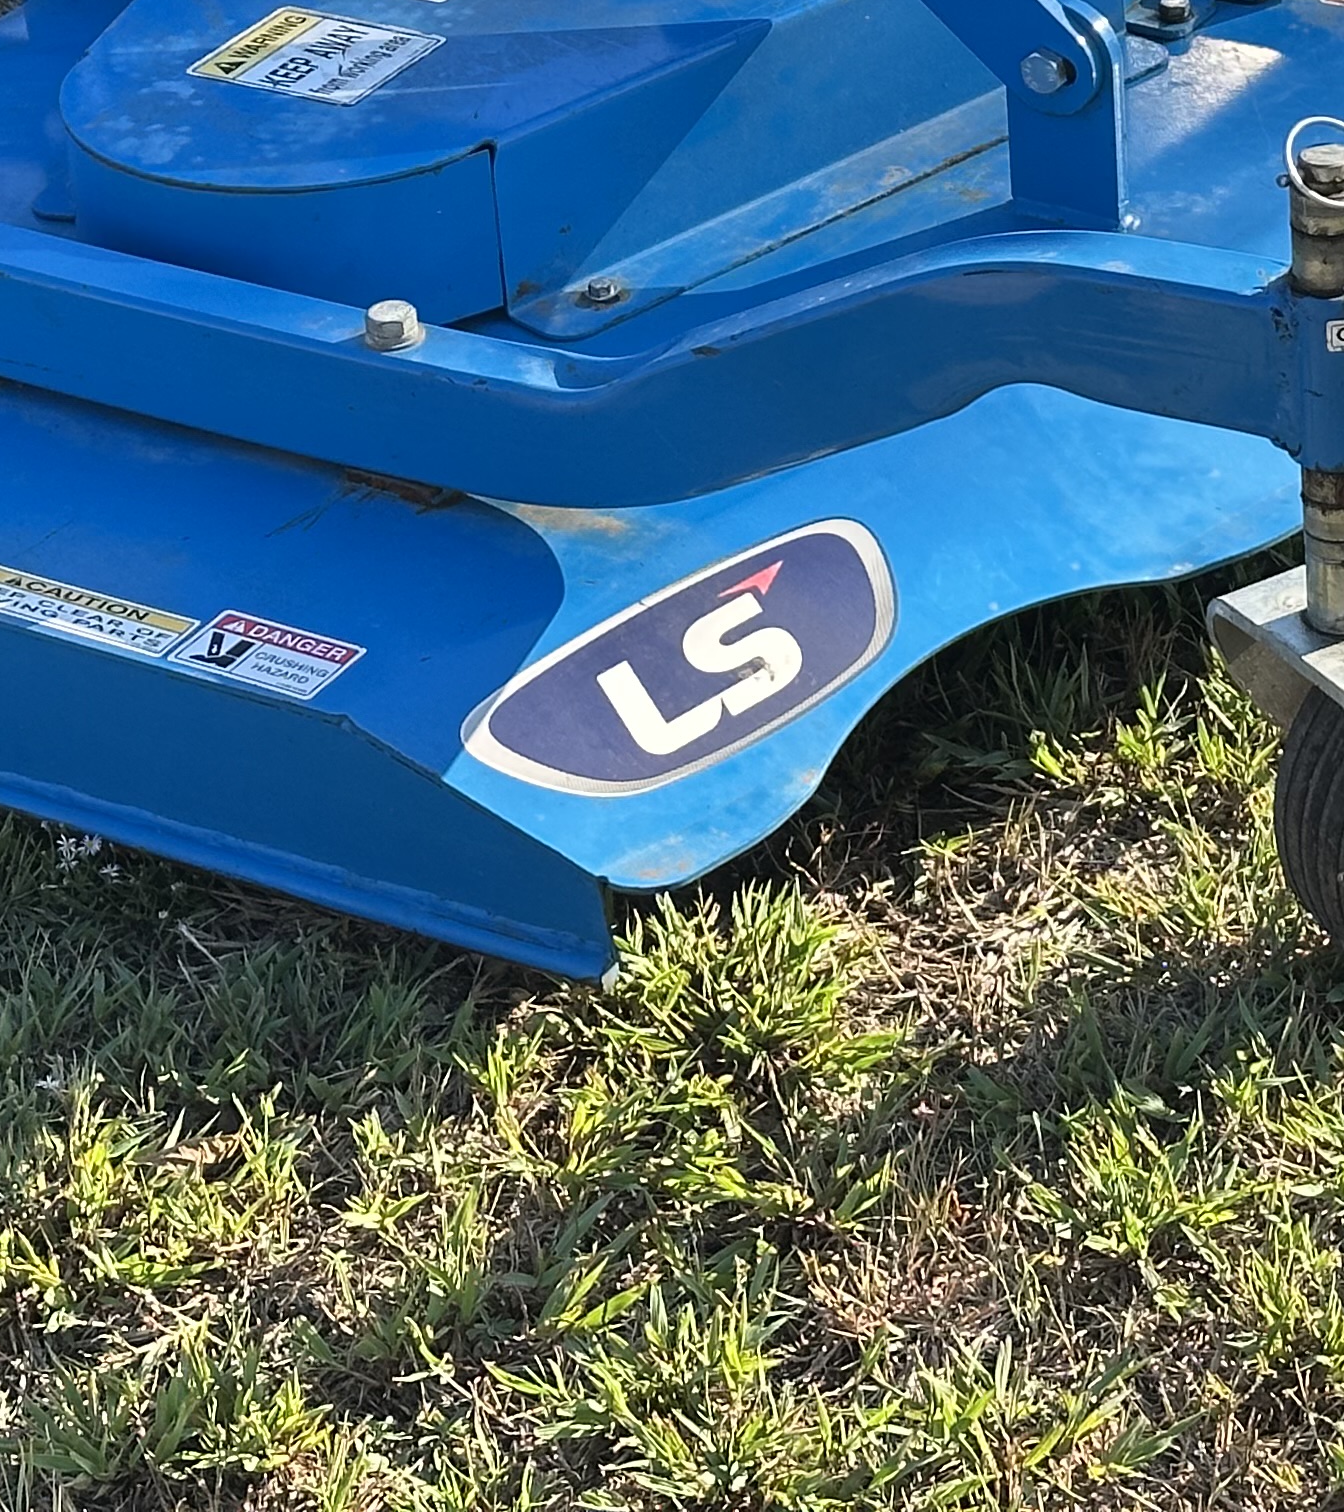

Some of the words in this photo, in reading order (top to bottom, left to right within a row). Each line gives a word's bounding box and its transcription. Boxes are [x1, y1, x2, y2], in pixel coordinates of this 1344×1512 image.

[232, 14, 307, 59] WARNING
[256, 57, 319, 89] KEEP
[304, 25, 370, 60] AWAY
[308, 77, 349, 96] from
[340, 50, 393, 79] working
[378, 35, 412, 53] area
[25, 581, 150, 621] CAUTION
[38, 599, 124, 628] CLEAR
[136, 627, 173, 640] OF
[72, 618, 162, 648] PARTS
[247, 624, 348, 662] DANGER
[250, 661, 310, 684] HAZARD
[254, 651, 330, 678] CRUSHING
[596, 591, 803, 756] LS
